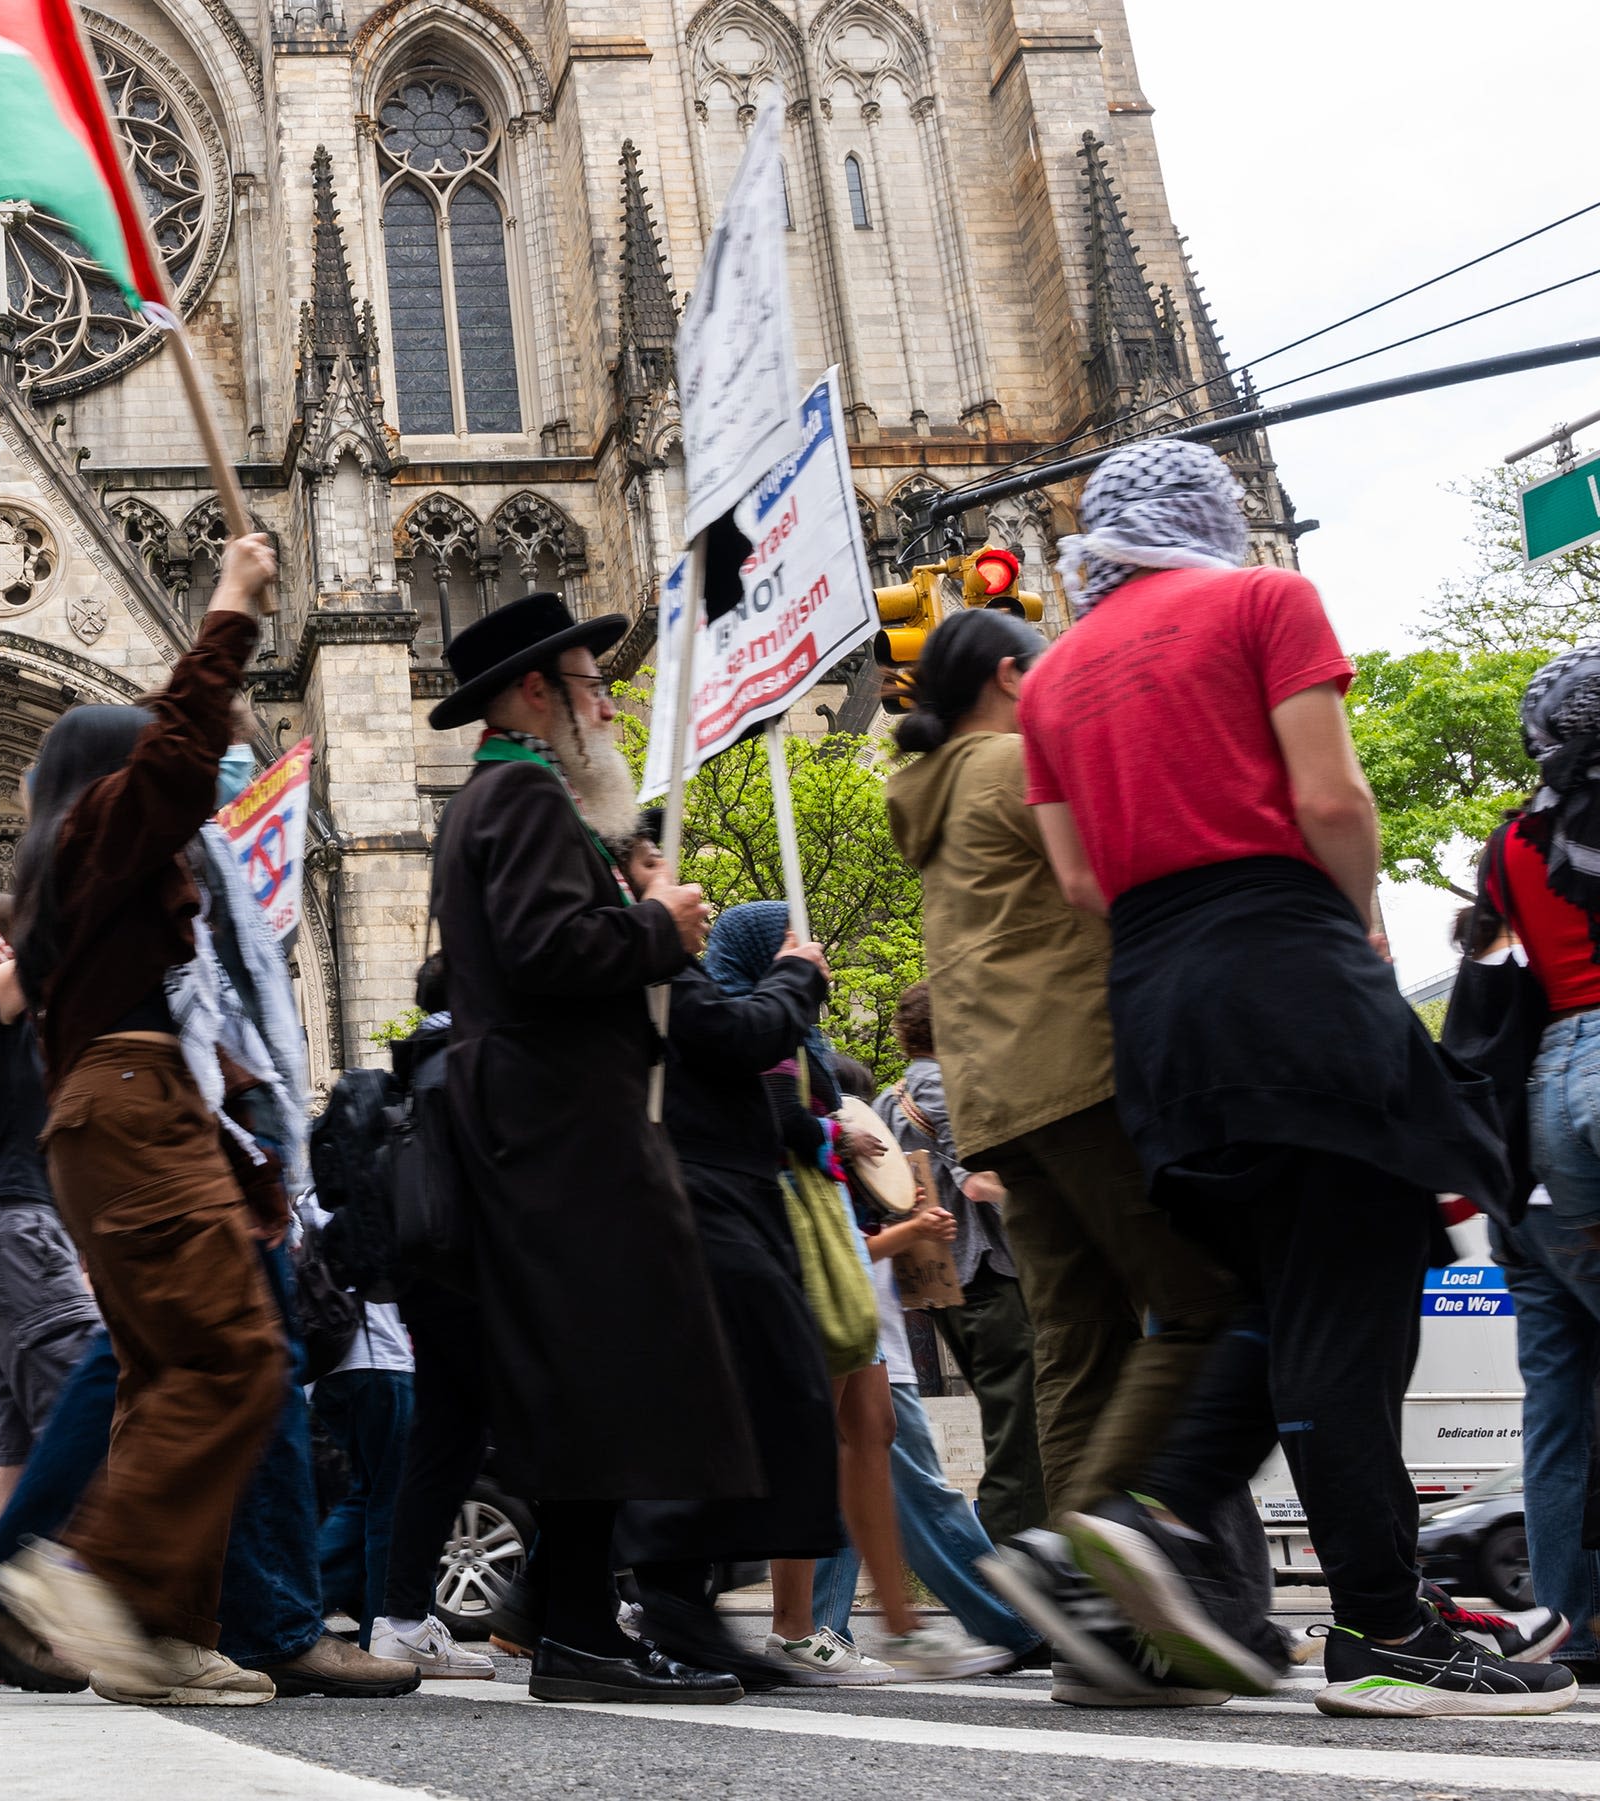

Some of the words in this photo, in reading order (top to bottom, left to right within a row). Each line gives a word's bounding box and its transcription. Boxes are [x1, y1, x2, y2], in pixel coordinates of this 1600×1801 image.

[739, 495, 800, 576] srael
[1441, 1270, 1484, 1285] Local
[1434, 1296, 1464, 1312] One
[1467, 1297, 1501, 1315] Way
[1437, 1427, 1494, 1439] Dedication
[1496, 1428, 1508, 1438] at
